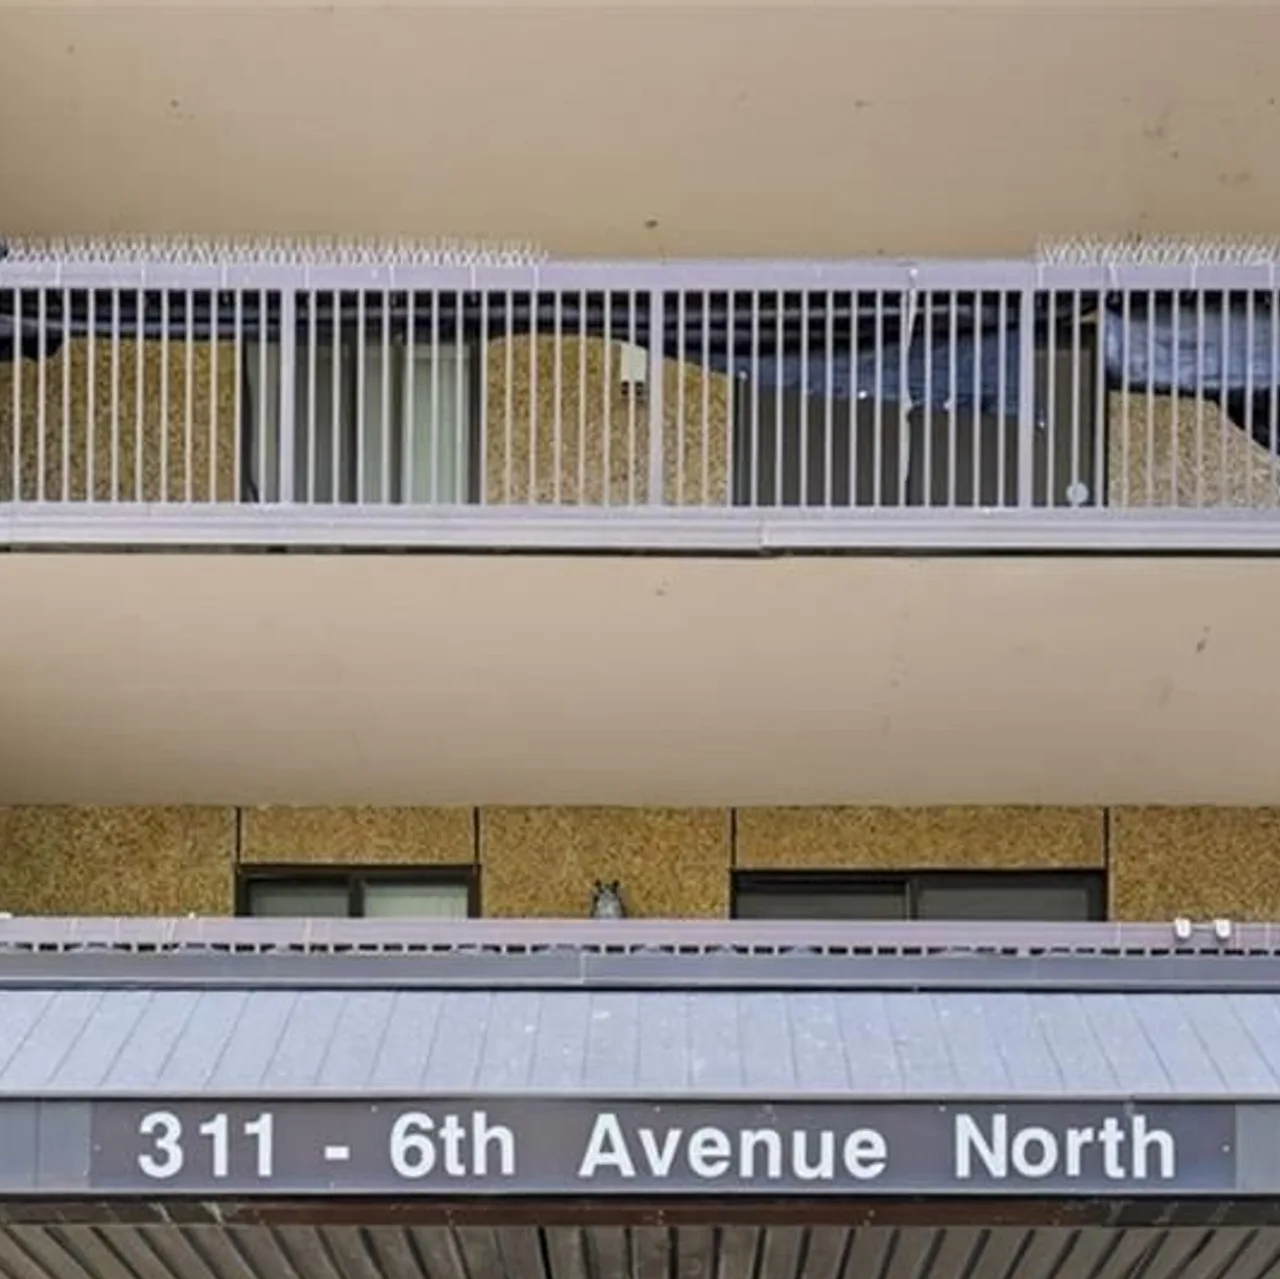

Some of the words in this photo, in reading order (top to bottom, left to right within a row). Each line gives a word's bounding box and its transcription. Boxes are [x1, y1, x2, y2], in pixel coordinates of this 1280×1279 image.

[137, 1110, 271, 1179] 311
[389, 1110, 515, 1178] 6th
[578, 1112, 887, 1179] Avenue
[953, 1112, 1176, 1179] North
